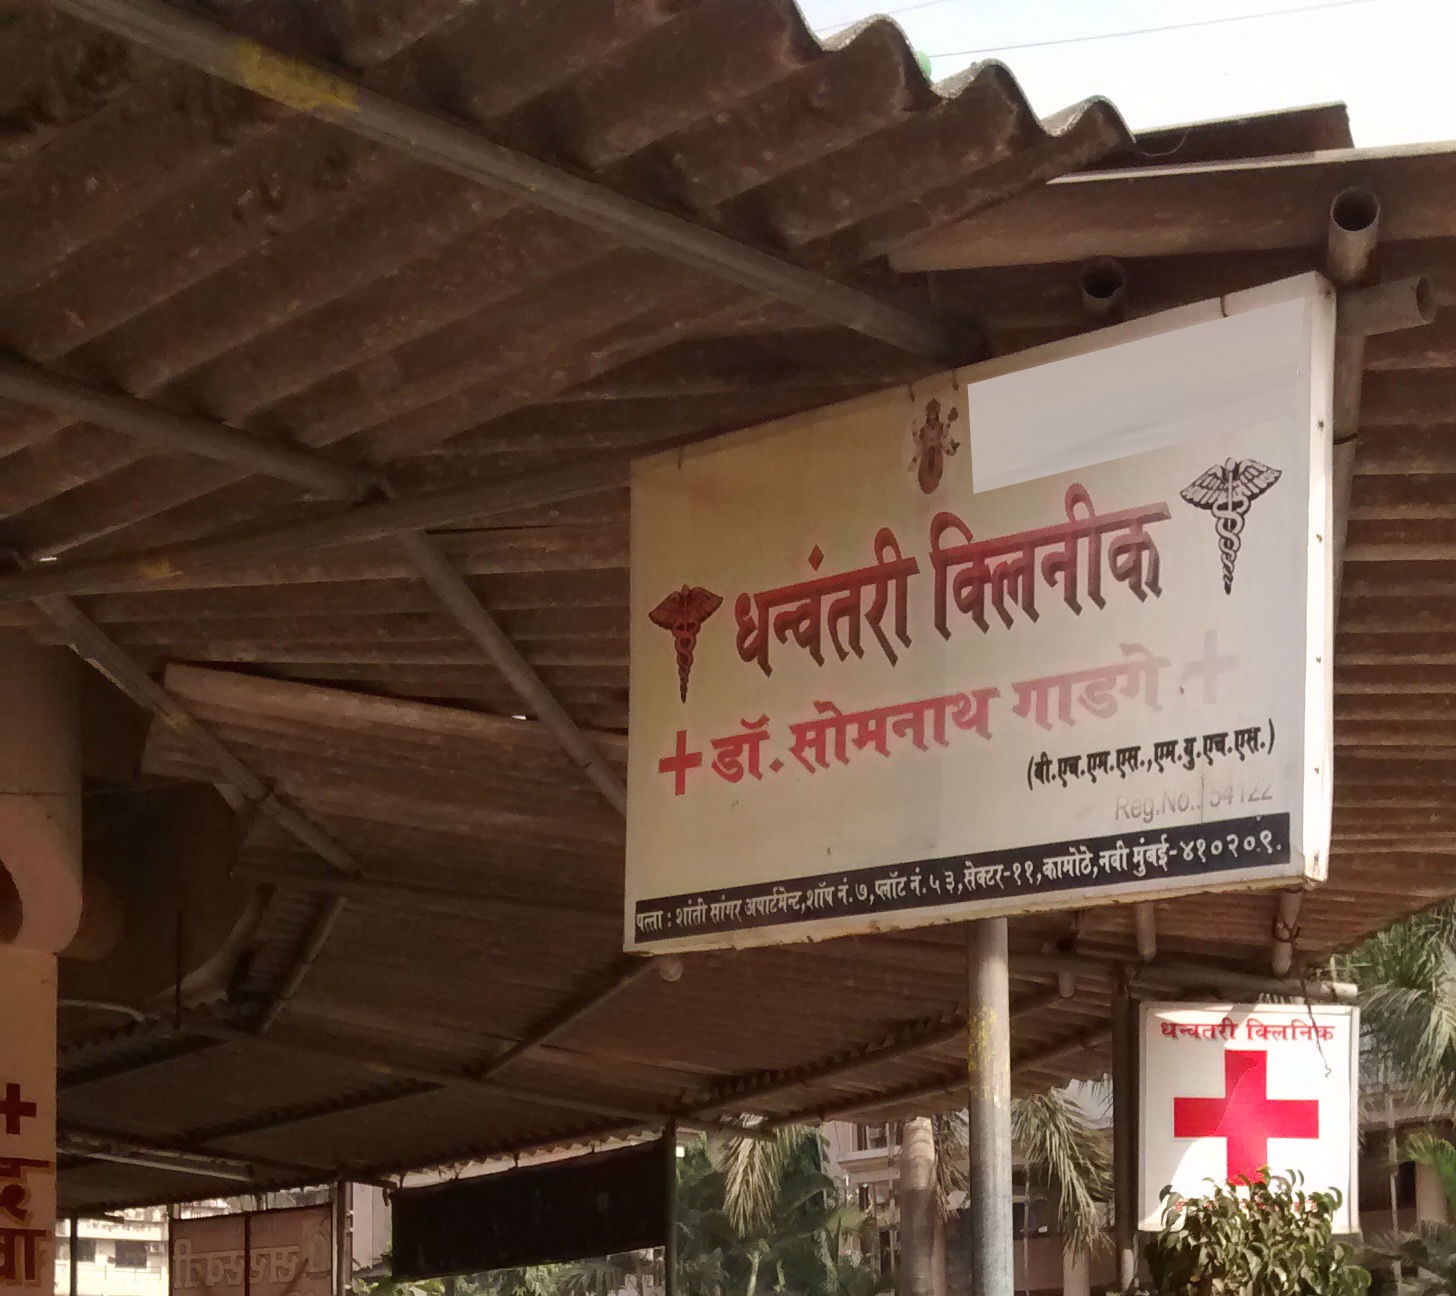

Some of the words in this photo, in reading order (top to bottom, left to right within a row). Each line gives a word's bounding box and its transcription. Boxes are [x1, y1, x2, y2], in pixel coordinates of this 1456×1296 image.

[735, 527, 920, 677] धन्वंतरी
[788, 687, 1001, 775] सोमनाथ
[1011, 642, 1172, 730] गाडगे
